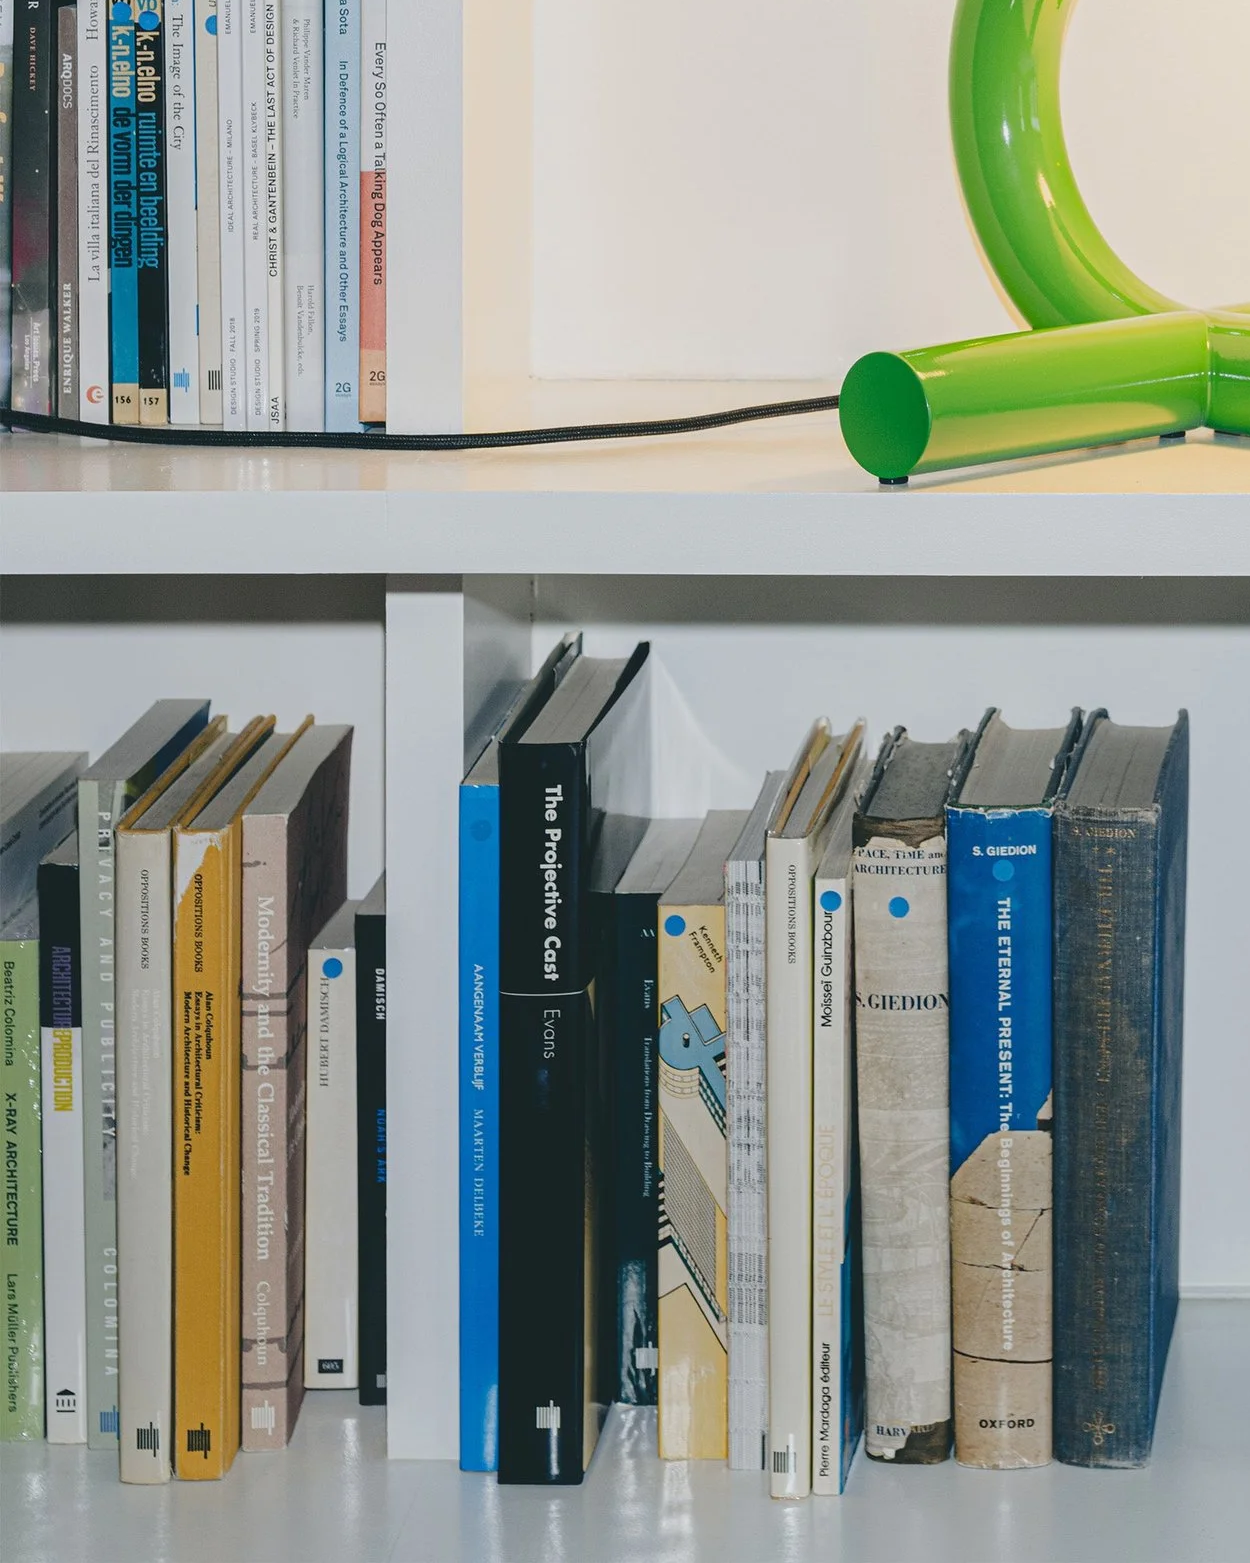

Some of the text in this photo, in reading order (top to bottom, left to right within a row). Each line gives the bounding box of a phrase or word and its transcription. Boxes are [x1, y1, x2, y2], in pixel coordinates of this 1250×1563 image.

[173, 15, 183, 37] The
[340, 9, 349, 34] Sota
[169, 44, 183, 79] Image
[173, 85, 185, 98] of
[173, 103, 184, 120] the
[170, 126, 184, 150] City
[540, 785, 563, 1058] The Projective Cast Evans
[998, 898, 1012, 1097] THE ETERNAL PRESENT:
[472, 964, 484, 1090] AANGENAAM VERBLIJF
[257, 896, 275, 1260] Modernity and the Classical Tradition
[6, 1093, 18, 1245] X-RAY ARCHITECTURE
[979, 1419, 1034, 1428] OXFORD
